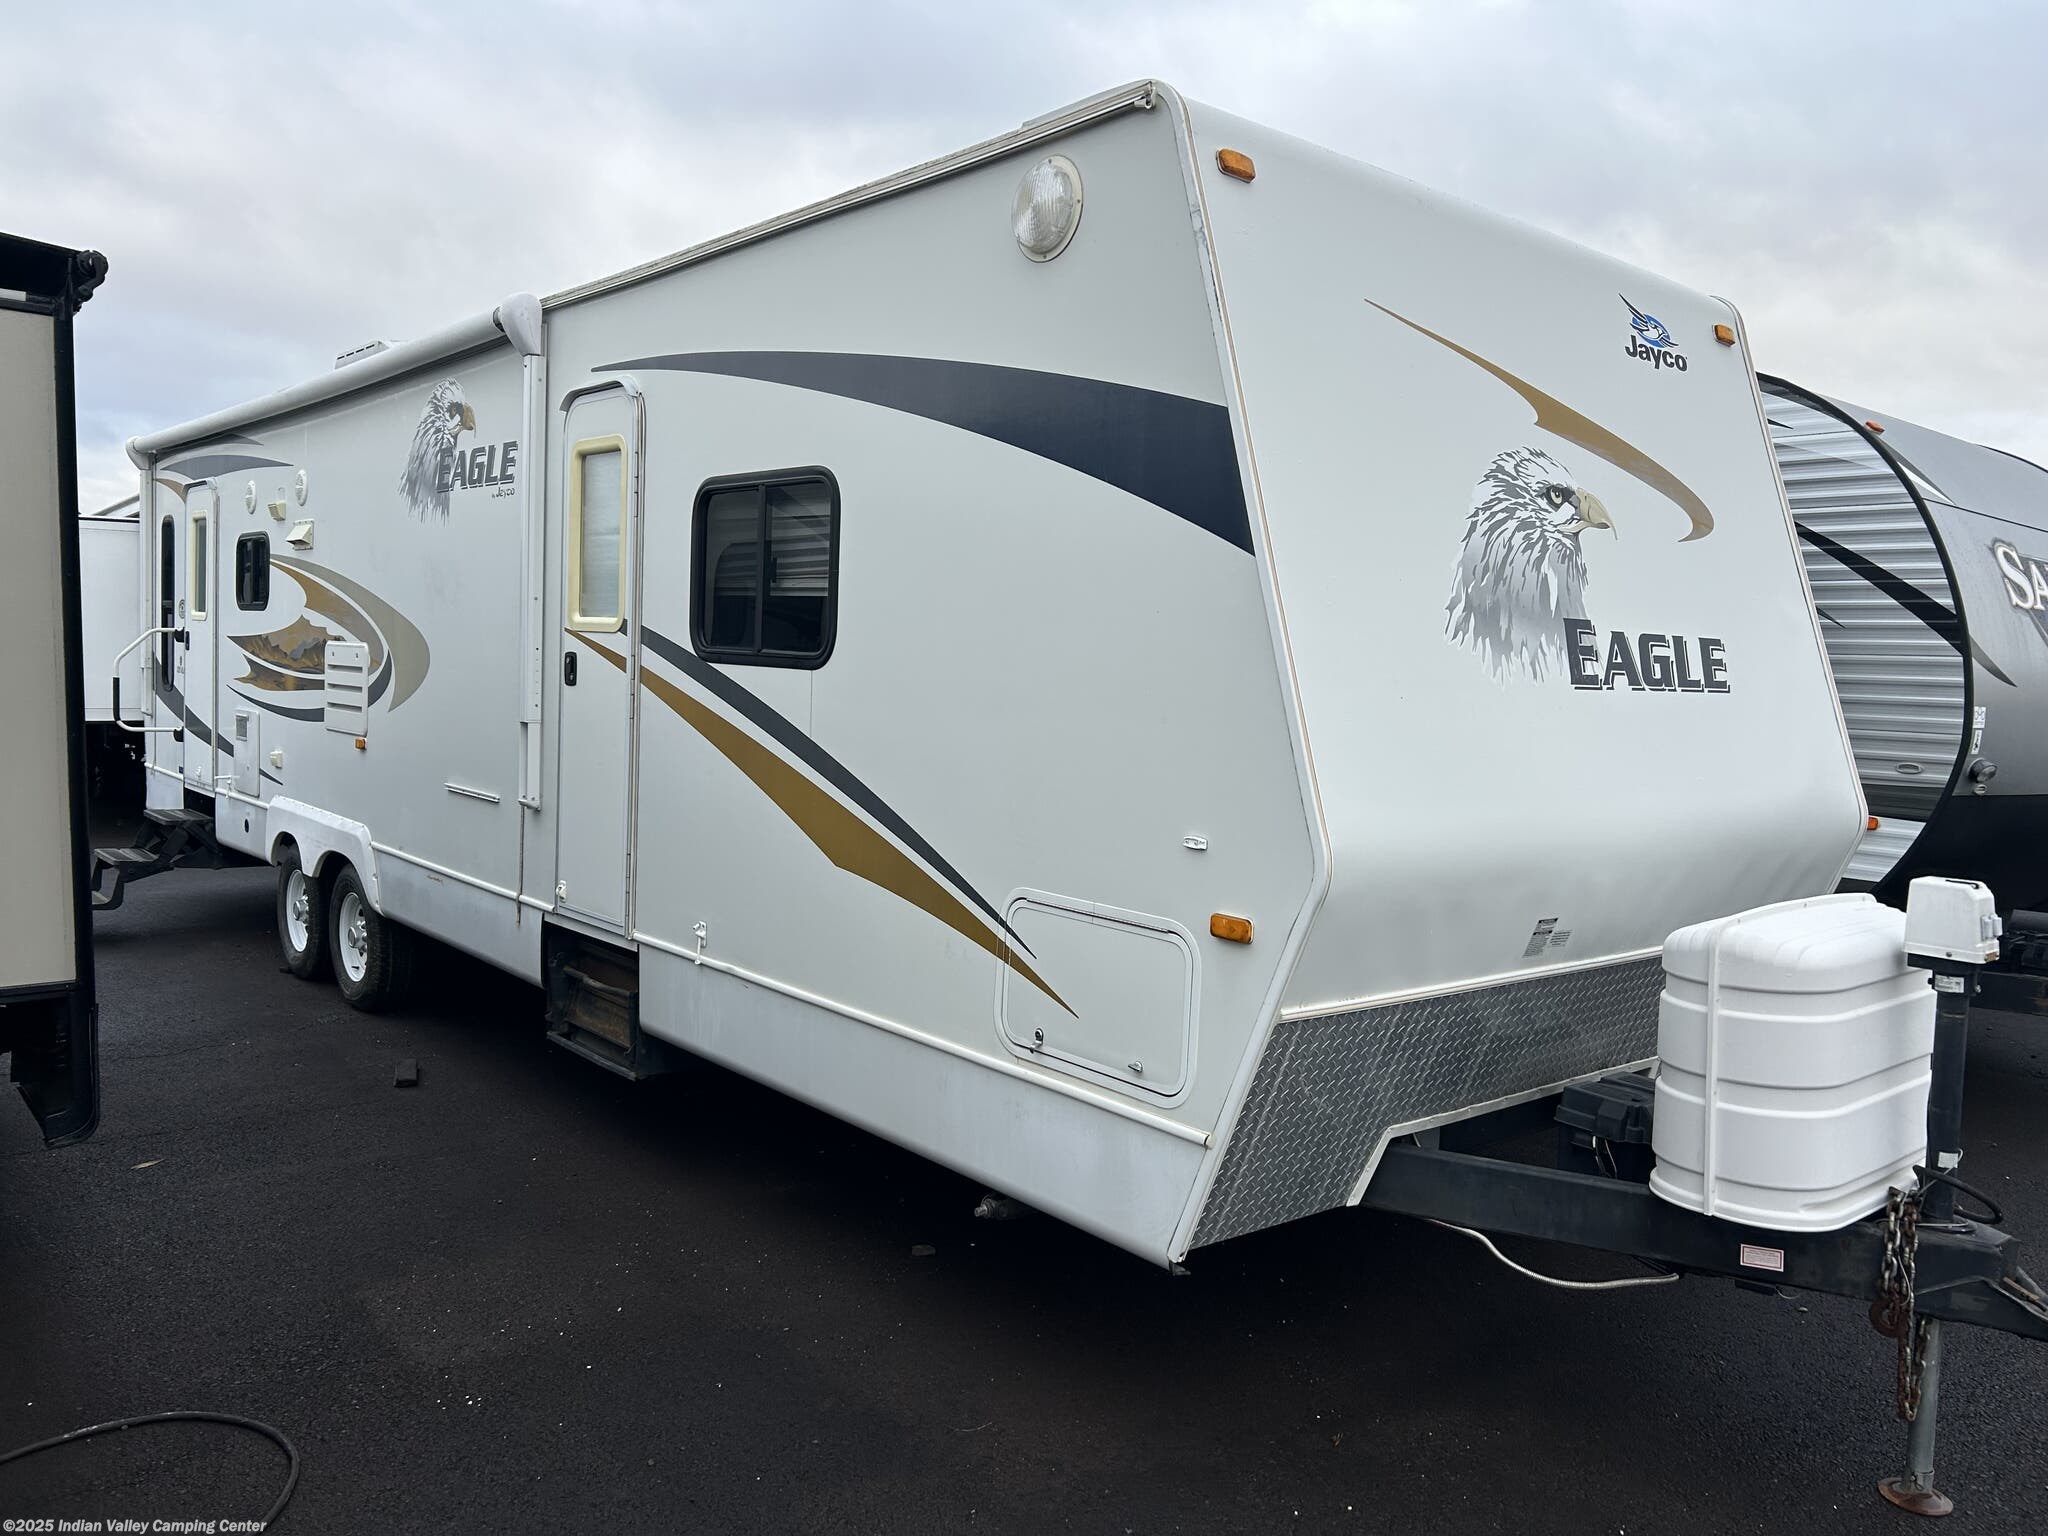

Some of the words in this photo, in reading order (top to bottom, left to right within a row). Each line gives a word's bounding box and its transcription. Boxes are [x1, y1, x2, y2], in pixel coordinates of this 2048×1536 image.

[1625, 335, 1687, 371] Jayco
[437, 441, 518, 493] EAGLE
[1994, 543, 2048, 610] SA
[1563, 617, 1730, 692] EAGLE
